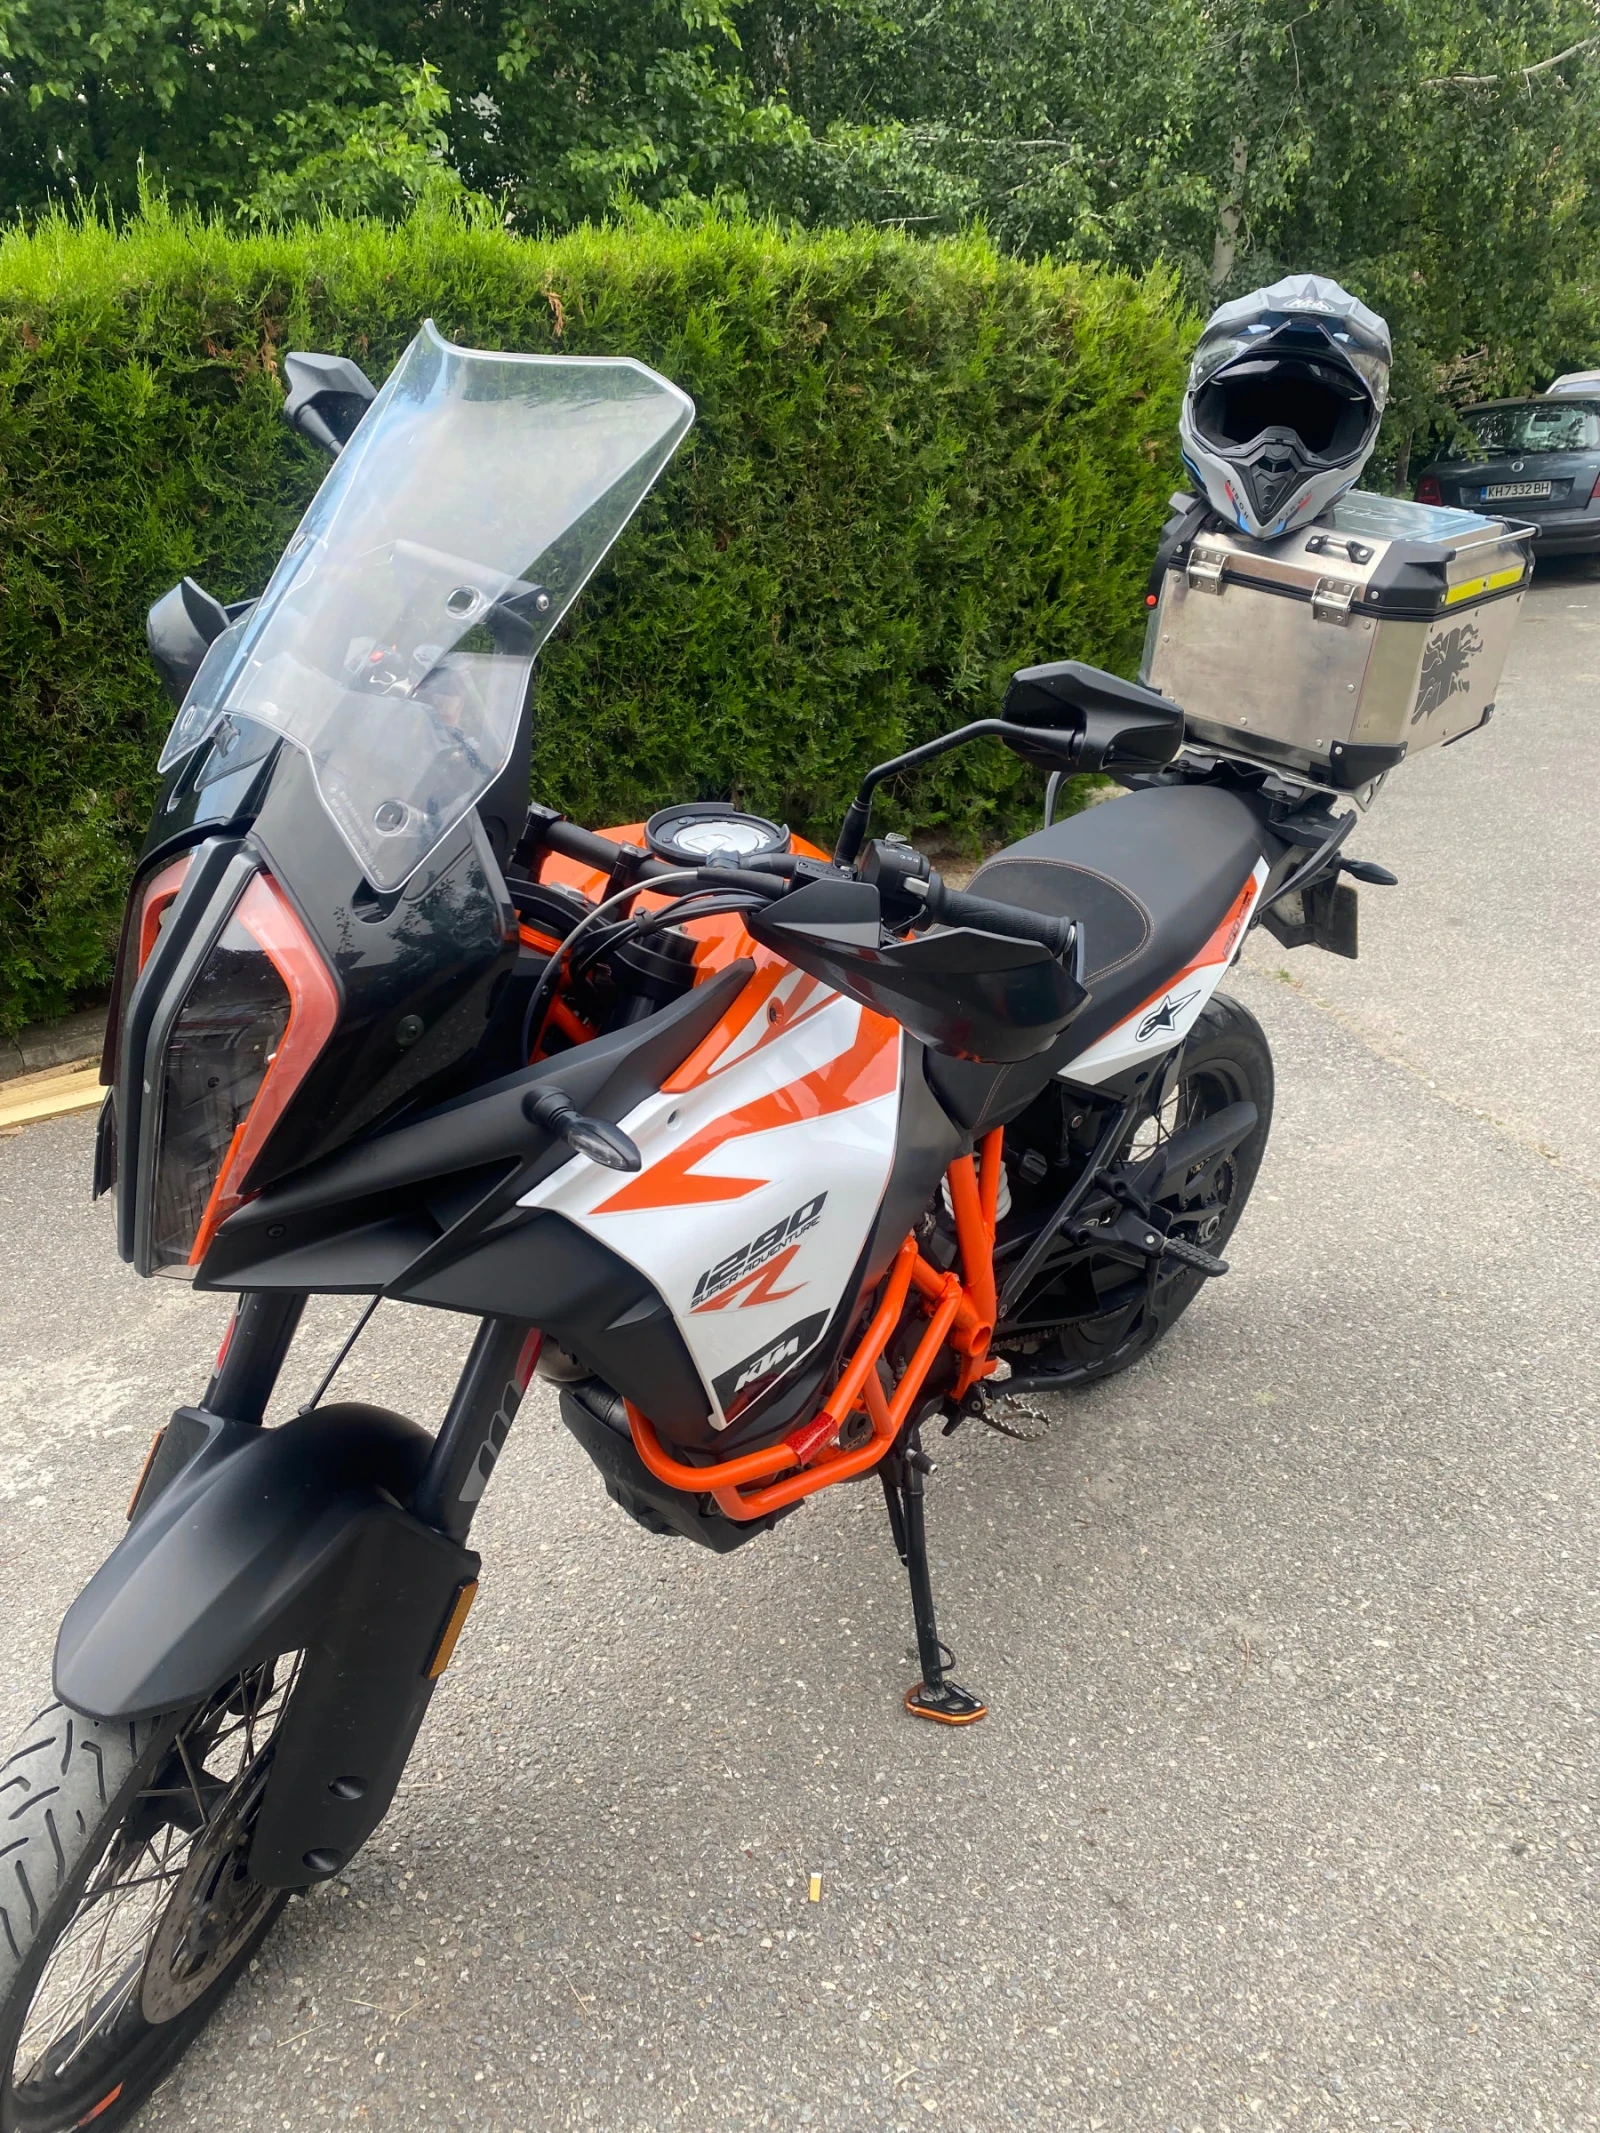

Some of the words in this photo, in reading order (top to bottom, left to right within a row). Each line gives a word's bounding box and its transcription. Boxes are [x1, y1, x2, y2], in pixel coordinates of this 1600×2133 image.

[690, 1215, 821, 1308] SUPER-ADVENTURE
[692, 1190, 829, 1299] 1290
[733, 1336, 799, 1393] KTM
